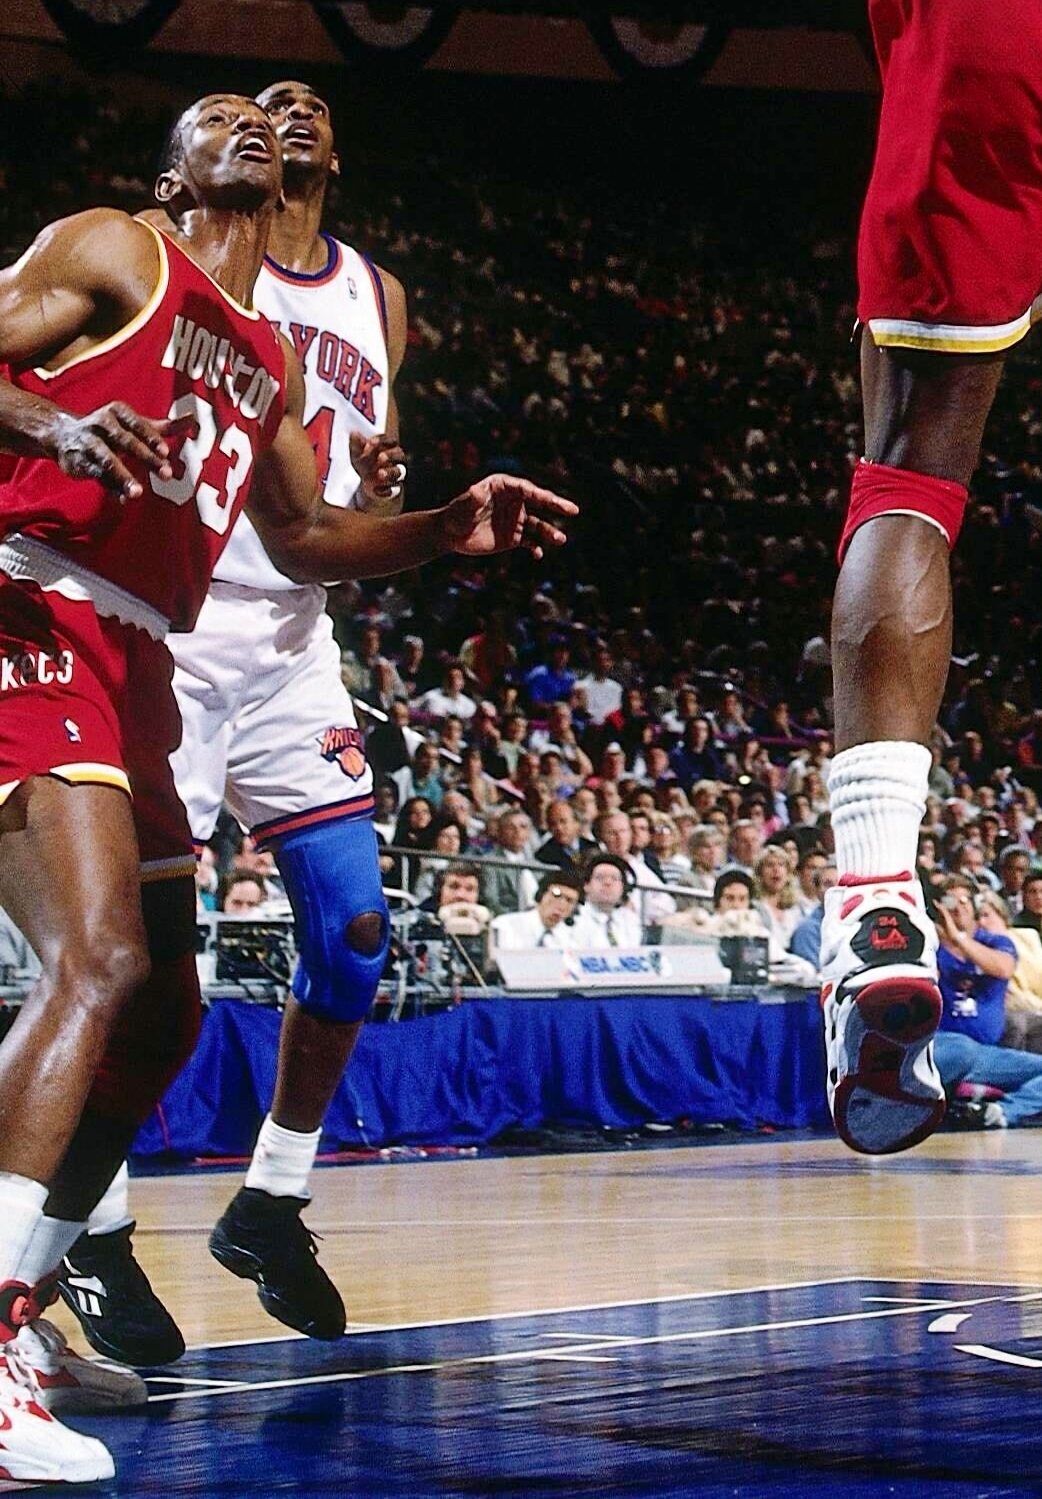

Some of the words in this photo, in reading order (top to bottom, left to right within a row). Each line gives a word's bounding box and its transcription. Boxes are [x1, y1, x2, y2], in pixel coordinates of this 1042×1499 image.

[289, 321, 384, 425] YORK
[150, 391, 254, 536] 33
[579, 957, 611, 973] NBA
